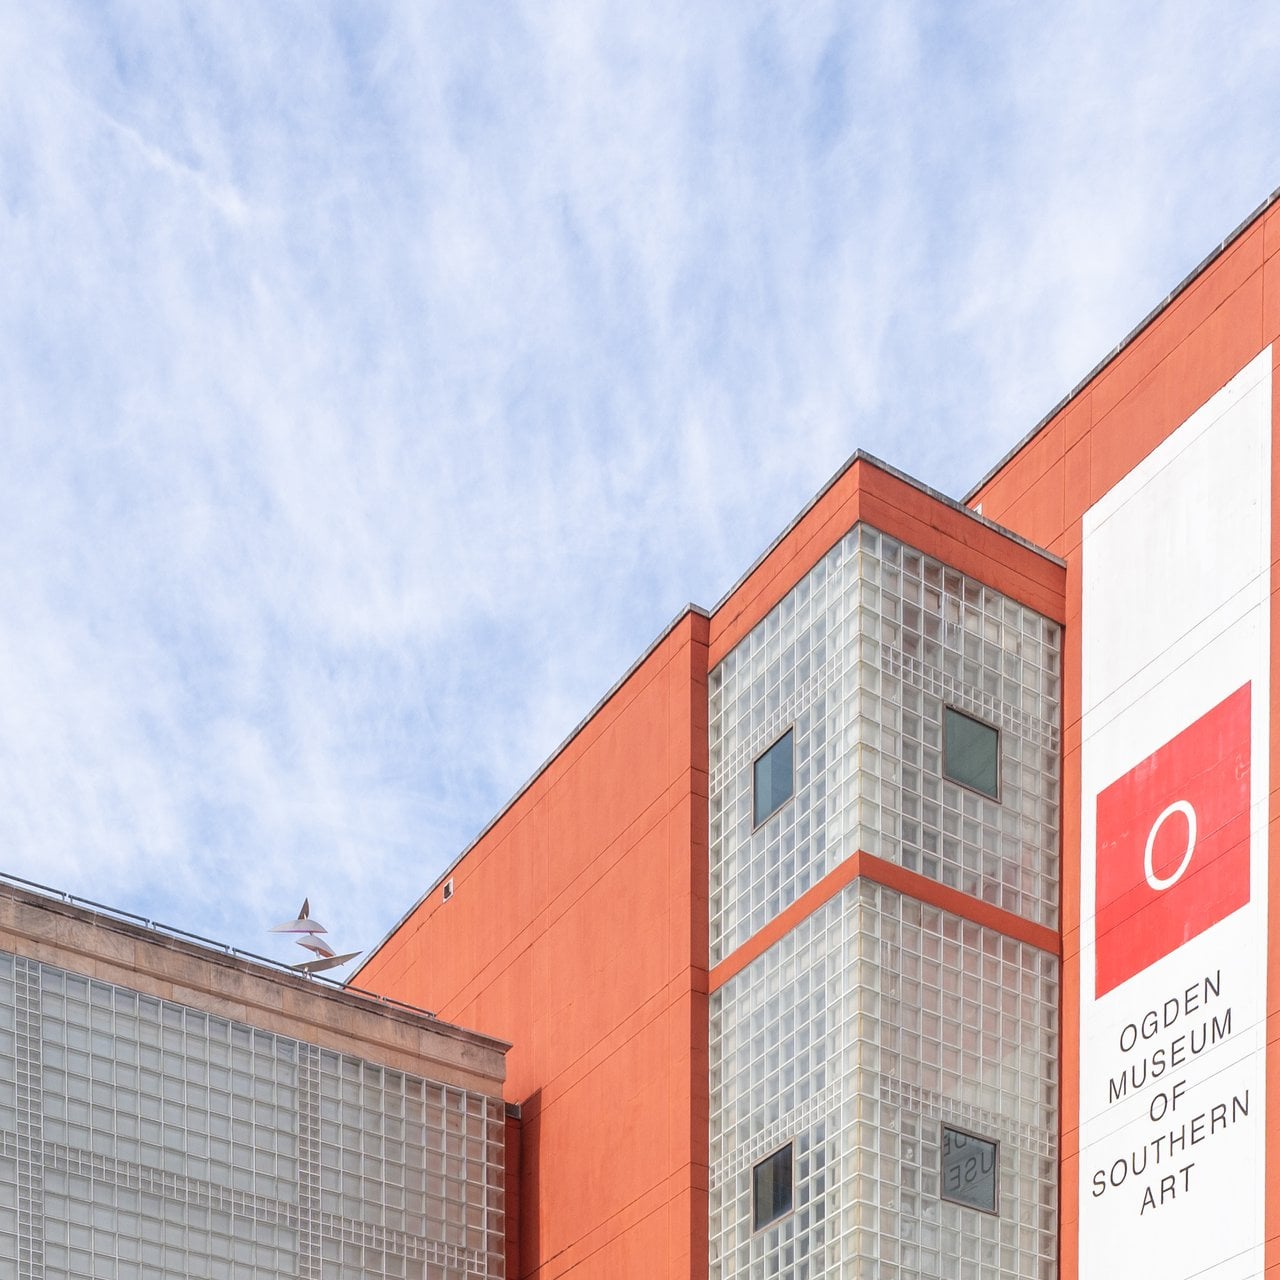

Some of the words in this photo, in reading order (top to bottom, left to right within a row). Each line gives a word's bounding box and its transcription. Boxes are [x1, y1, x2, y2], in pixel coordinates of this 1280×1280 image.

[1144, 799, 1197, 891] O
[1119, 969, 1221, 1053] OGDEN
[1108, 1007, 1232, 1104] MUSEUM
[1092, 1089, 1250, 1198] SOUTHERN
[1149, 1079, 1187, 1122] OF
[1140, 1162, 1196, 1216] ART
